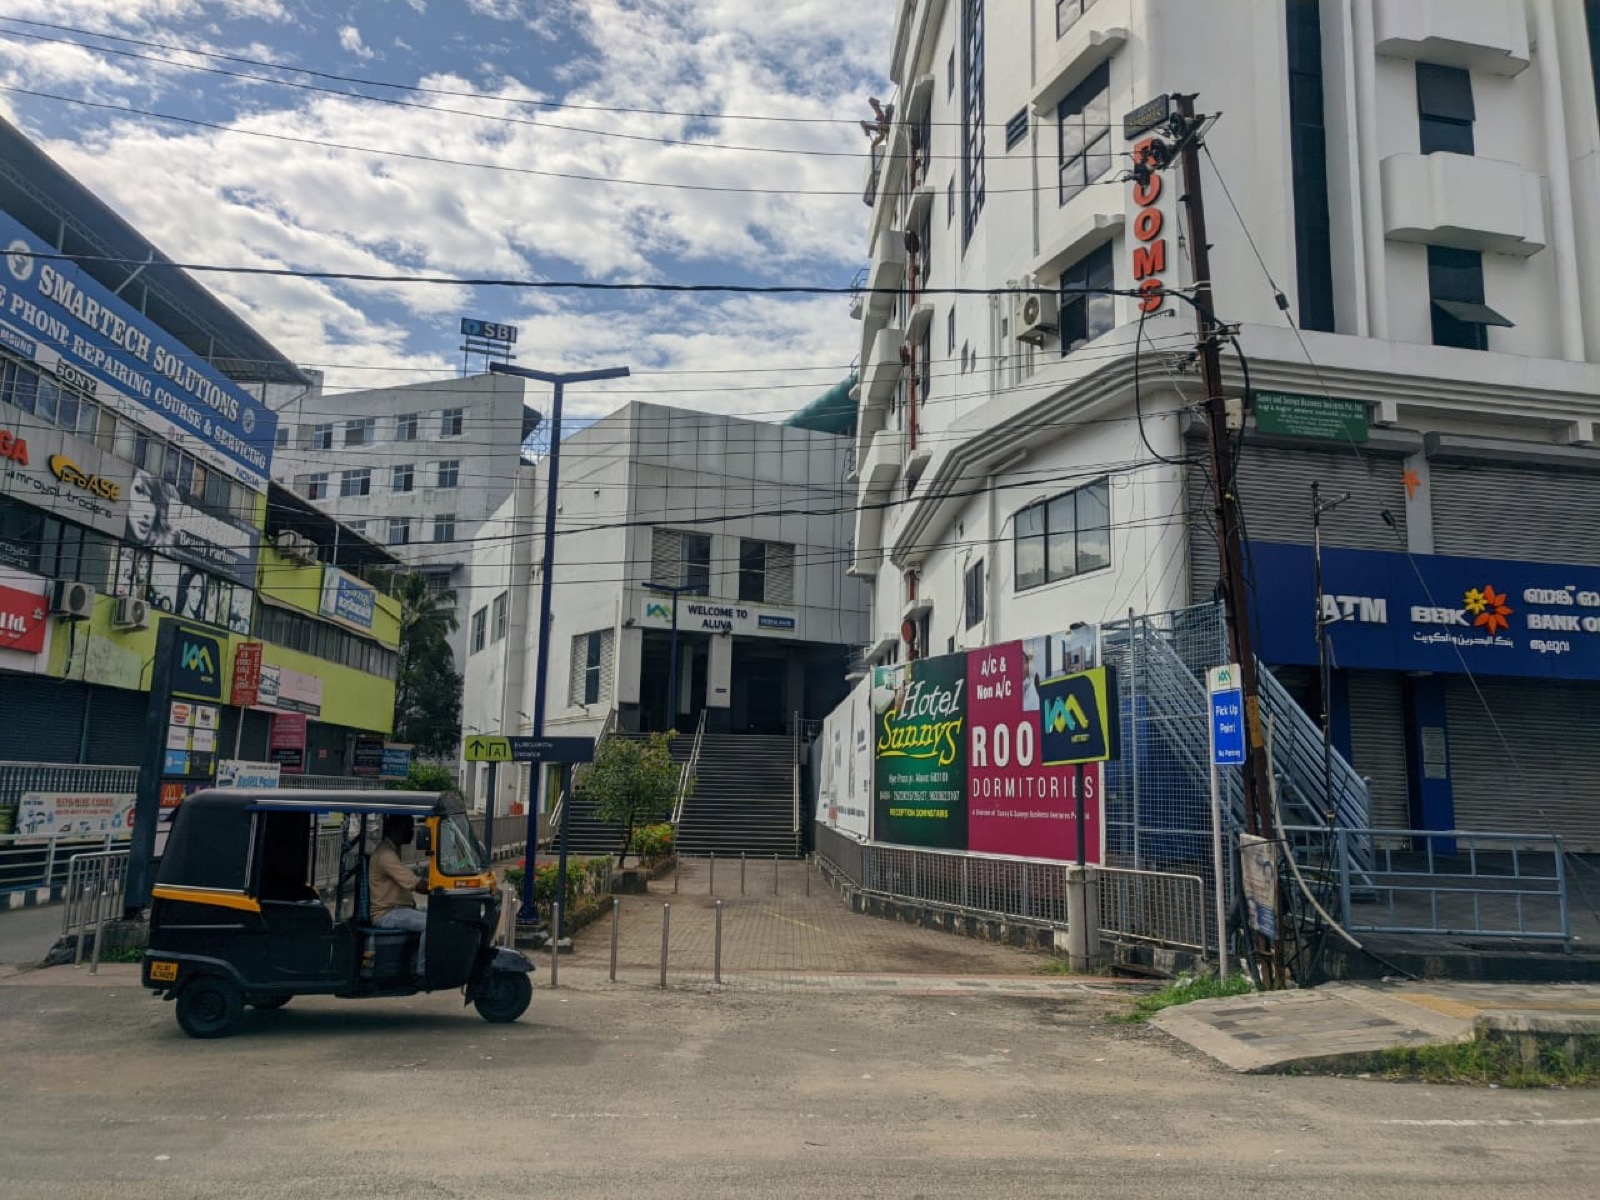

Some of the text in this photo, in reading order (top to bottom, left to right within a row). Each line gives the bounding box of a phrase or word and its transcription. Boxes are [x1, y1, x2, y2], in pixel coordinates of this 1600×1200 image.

[39, 264, 239, 422] SMARTECH SOLUTIONS
[484, 323, 516, 341] SBI
[10, 293, 69, 347] PHONE
[71, 334, 151, 397] REPAIRING
[155, 387, 201, 431] COURSE
[203, 419, 213, 438] &
[214, 425, 267, 470] SERVICING
[56, 361, 97, 393] SONY
[66, 490, 113, 518] traders
[688, 605, 748, 620] WELCOME TO
[1319, 594, 1387, 623] ATM
[1410, 605, 1470, 626] BBK
[702, 618, 732, 631] ALUVA
[1527, 614, 1600, 632] BANK O
[981, 652, 1007, 676] A/C &
[897, 678, 965, 721] Hotel
[976, 674, 1012, 701] Non A/C
[1215, 705, 1239, 717] Pick Up
[972, 721, 1034, 767] ROO
